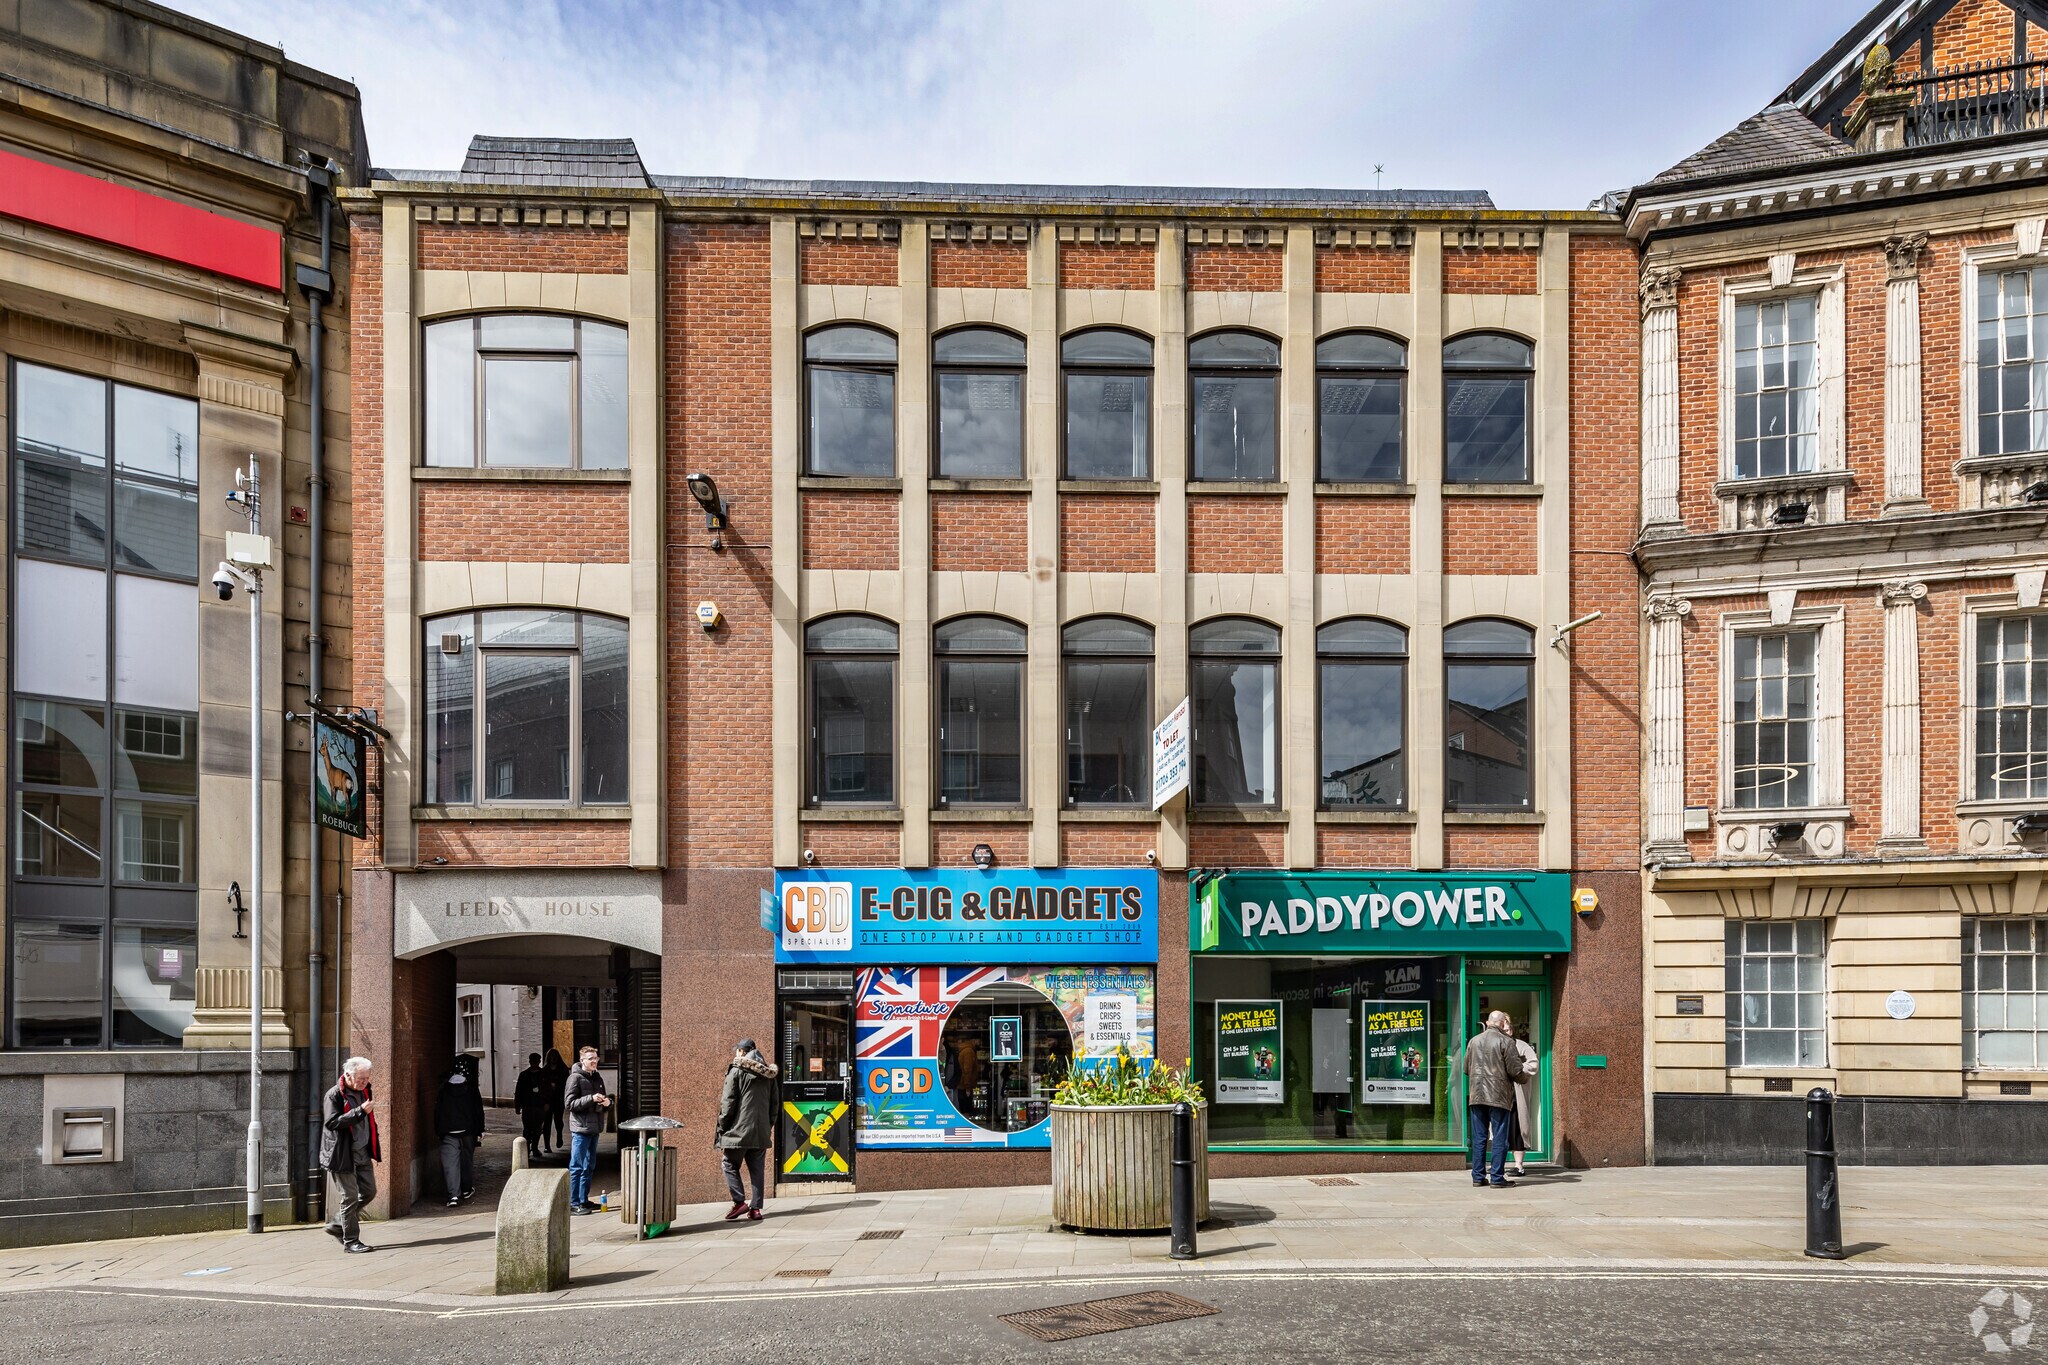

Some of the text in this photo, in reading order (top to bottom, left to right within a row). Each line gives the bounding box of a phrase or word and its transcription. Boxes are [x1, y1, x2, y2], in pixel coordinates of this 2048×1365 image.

[1162, 729, 1179, 750] TO LET
[322, 813, 358, 834] ROEBUCK
[445, 902, 614, 917] LEEDS HOUSE
[860, 886, 1142, 921] E-CIG & GADGETS
[785, 886, 850, 934] CBD
[788, 938, 846, 946] SPECIALIST
[862, 932, 1141, 942] ONE STOP VAPE AND GADGET SHOP
[1045, 974, 1146, 990] WE SELL ESSENTIALS
[869, 1000, 950, 1020] Signature
[1100, 1002, 1121, 1010] DRINKS
[1100, 1012, 1120, 1020] CRISPS
[1221, 1009, 1275, 1022] MONEY BACK
[1368, 1010, 1422, 1022] MONEY BACK
[1098, 1022, 1122, 1030] SWEETS
[1222, 1018, 1276, 1030] AS A FREE BET
[1369, 1022, 1379, 1030] AS
[1390, 1020, 1407, 1028] FREE
[1410, 1018, 1423, 1026] BET
[1090, 1032, 1131, 1040] & ESSENTIALS
[868, 1067, 933, 1094] CBD
